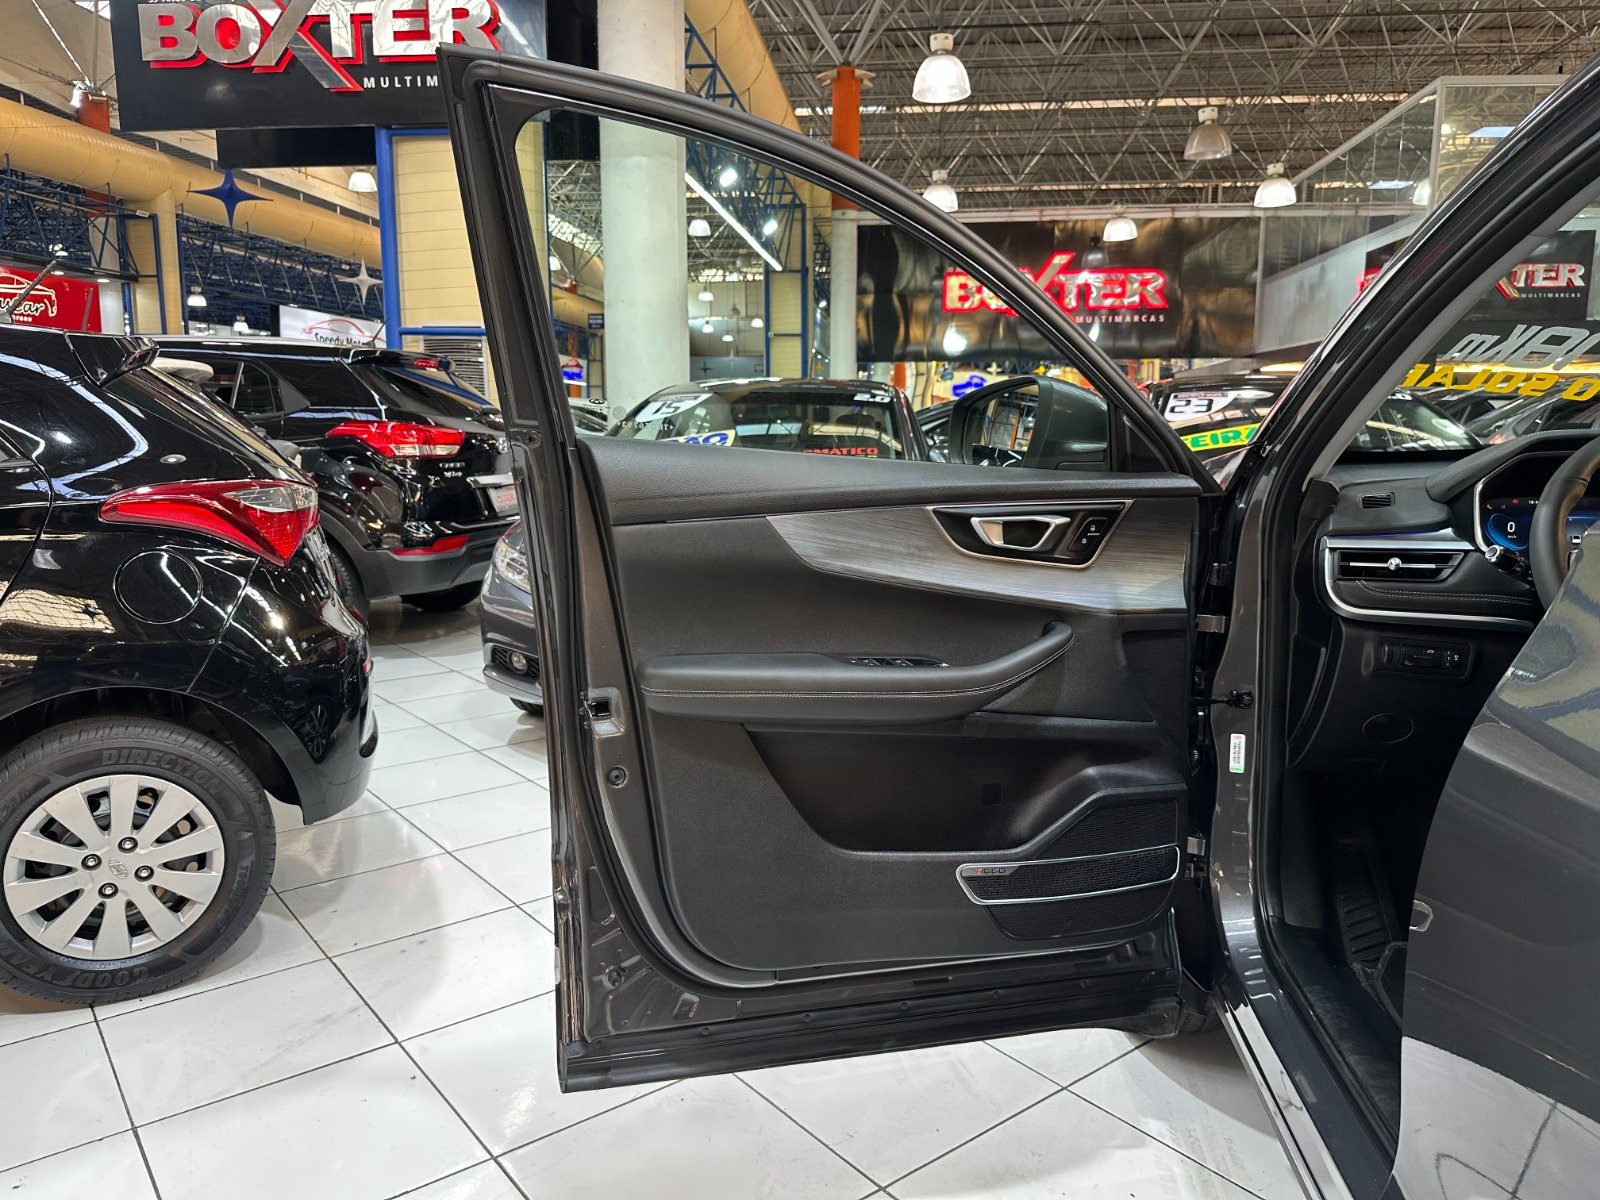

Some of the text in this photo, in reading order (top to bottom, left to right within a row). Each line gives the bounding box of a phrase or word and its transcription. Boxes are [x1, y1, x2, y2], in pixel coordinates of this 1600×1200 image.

[137, 0, 502, 91] BOXTER
[1076, 314, 1165, 324] MULTIMARCAS
[1169, 399, 1214, 414] 23
[1507, 522, 1515, 533] 0
